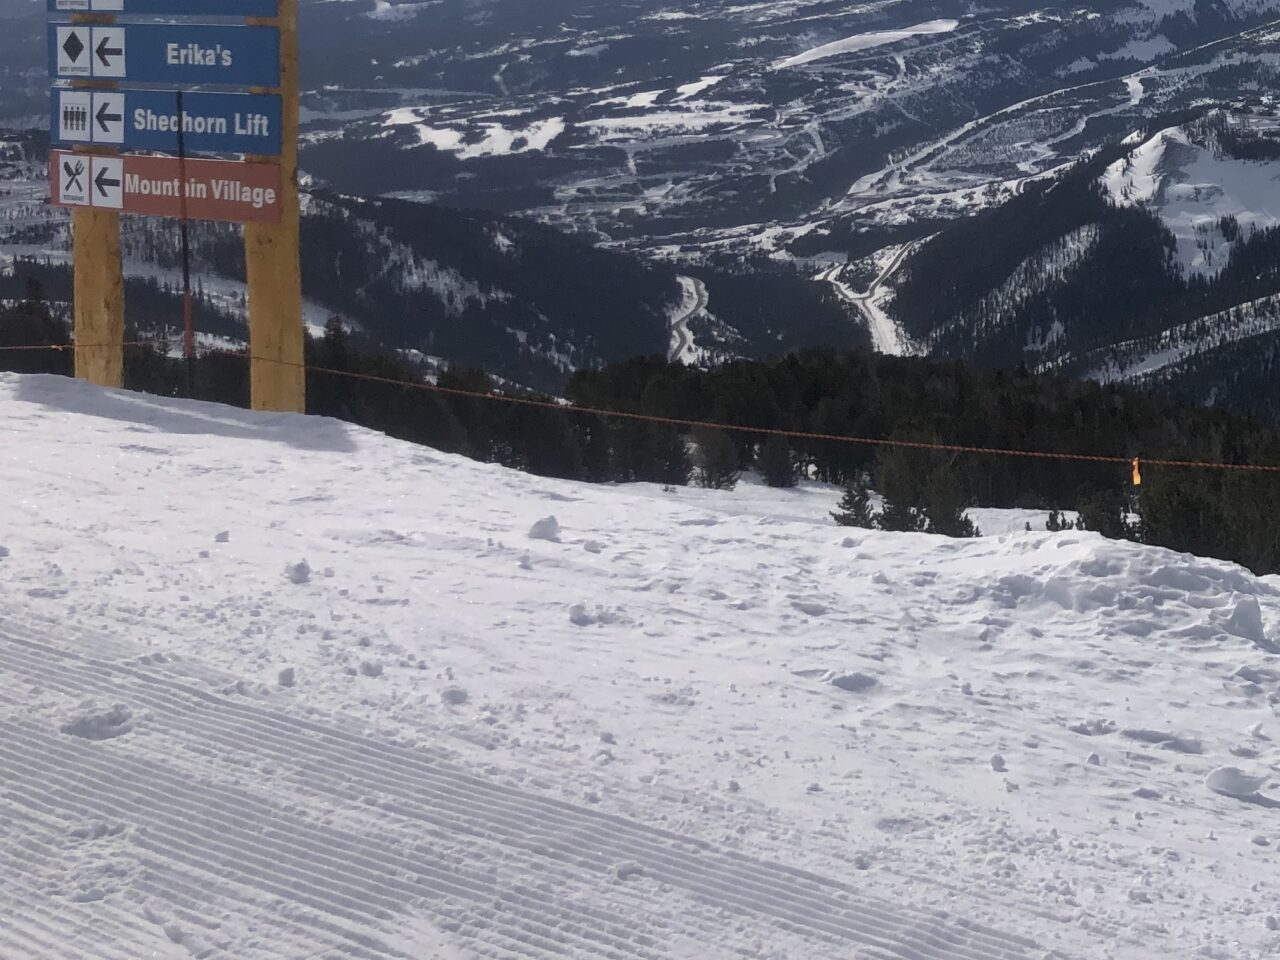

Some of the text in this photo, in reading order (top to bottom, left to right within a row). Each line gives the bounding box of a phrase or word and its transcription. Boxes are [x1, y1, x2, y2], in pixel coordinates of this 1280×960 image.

[167, 43, 232, 66] Erika's
[235, 113, 269, 136] Lift
[211, 179, 275, 208] Village
